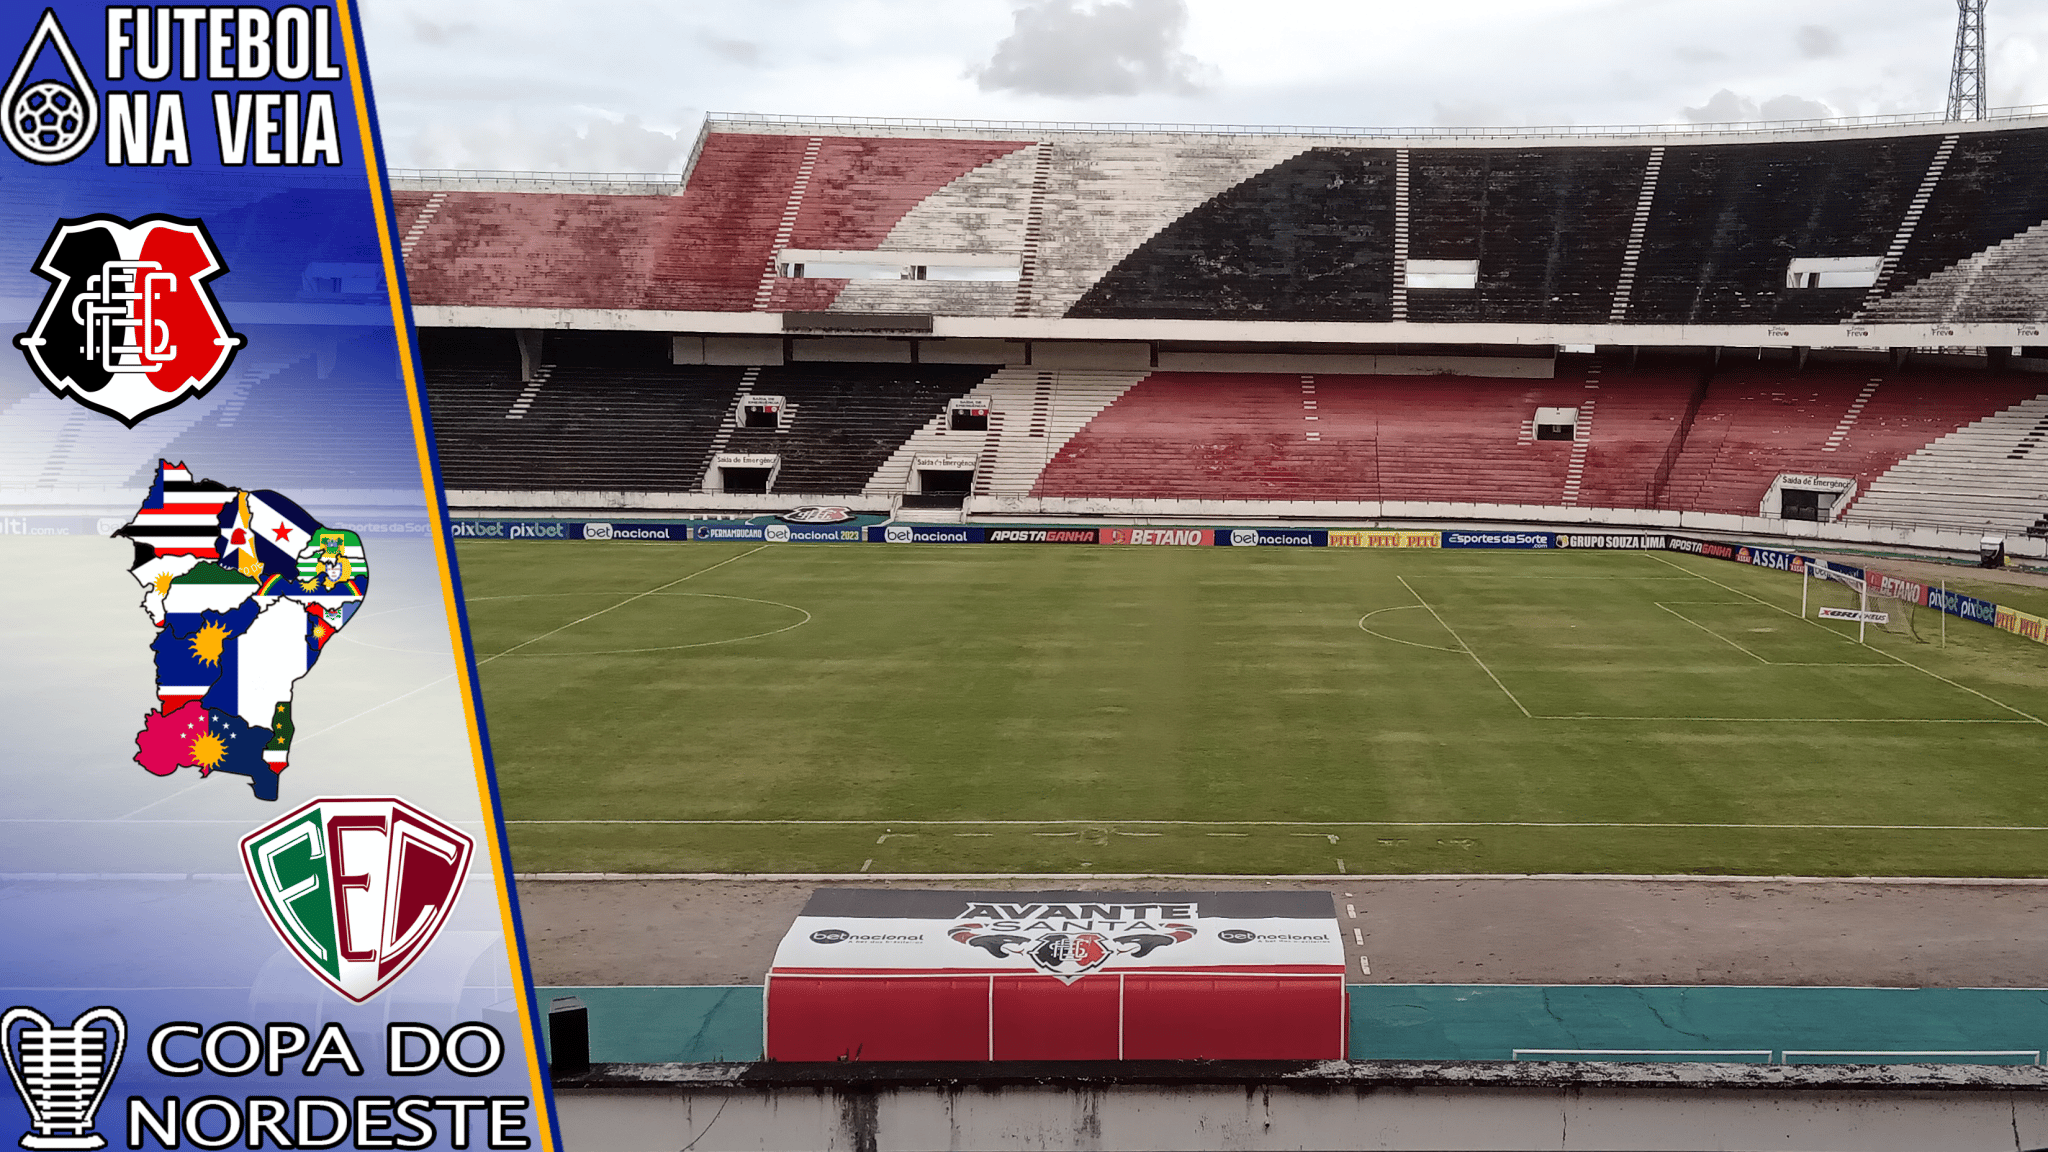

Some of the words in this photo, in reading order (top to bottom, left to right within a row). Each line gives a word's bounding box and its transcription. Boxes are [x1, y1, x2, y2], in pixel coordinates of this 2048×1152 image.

[451, 522, 504, 537] pixbet
[510, 522, 563, 540] pixbet
[710, 528, 762, 539] PERNAMBUCANO
[840, 531, 859, 540] 2023
[990, 530, 1095, 543] APOSTAGANHA
[1130, 529, 1202, 546] BETANO
[1448, 533, 1501, 545] Esportes
[1501, 534, 1516, 544] da
[1516, 534, 1548, 544] Sorte
[1570, 535, 1605, 548] GRUPO
[1605, 536, 1639, 549] SOUZA
[1640, 536, 1666, 549] LIMA
[1669, 538, 1733, 558] APOSTAGANHA
[1881, 576, 1921, 603] BETANO
[1928, 588, 1959, 613] pixbet
[1960, 598, 1995, 623] pixbet
[962, 904, 1192, 920] AVANTE
[991, 921, 1157, 931] SANTA
